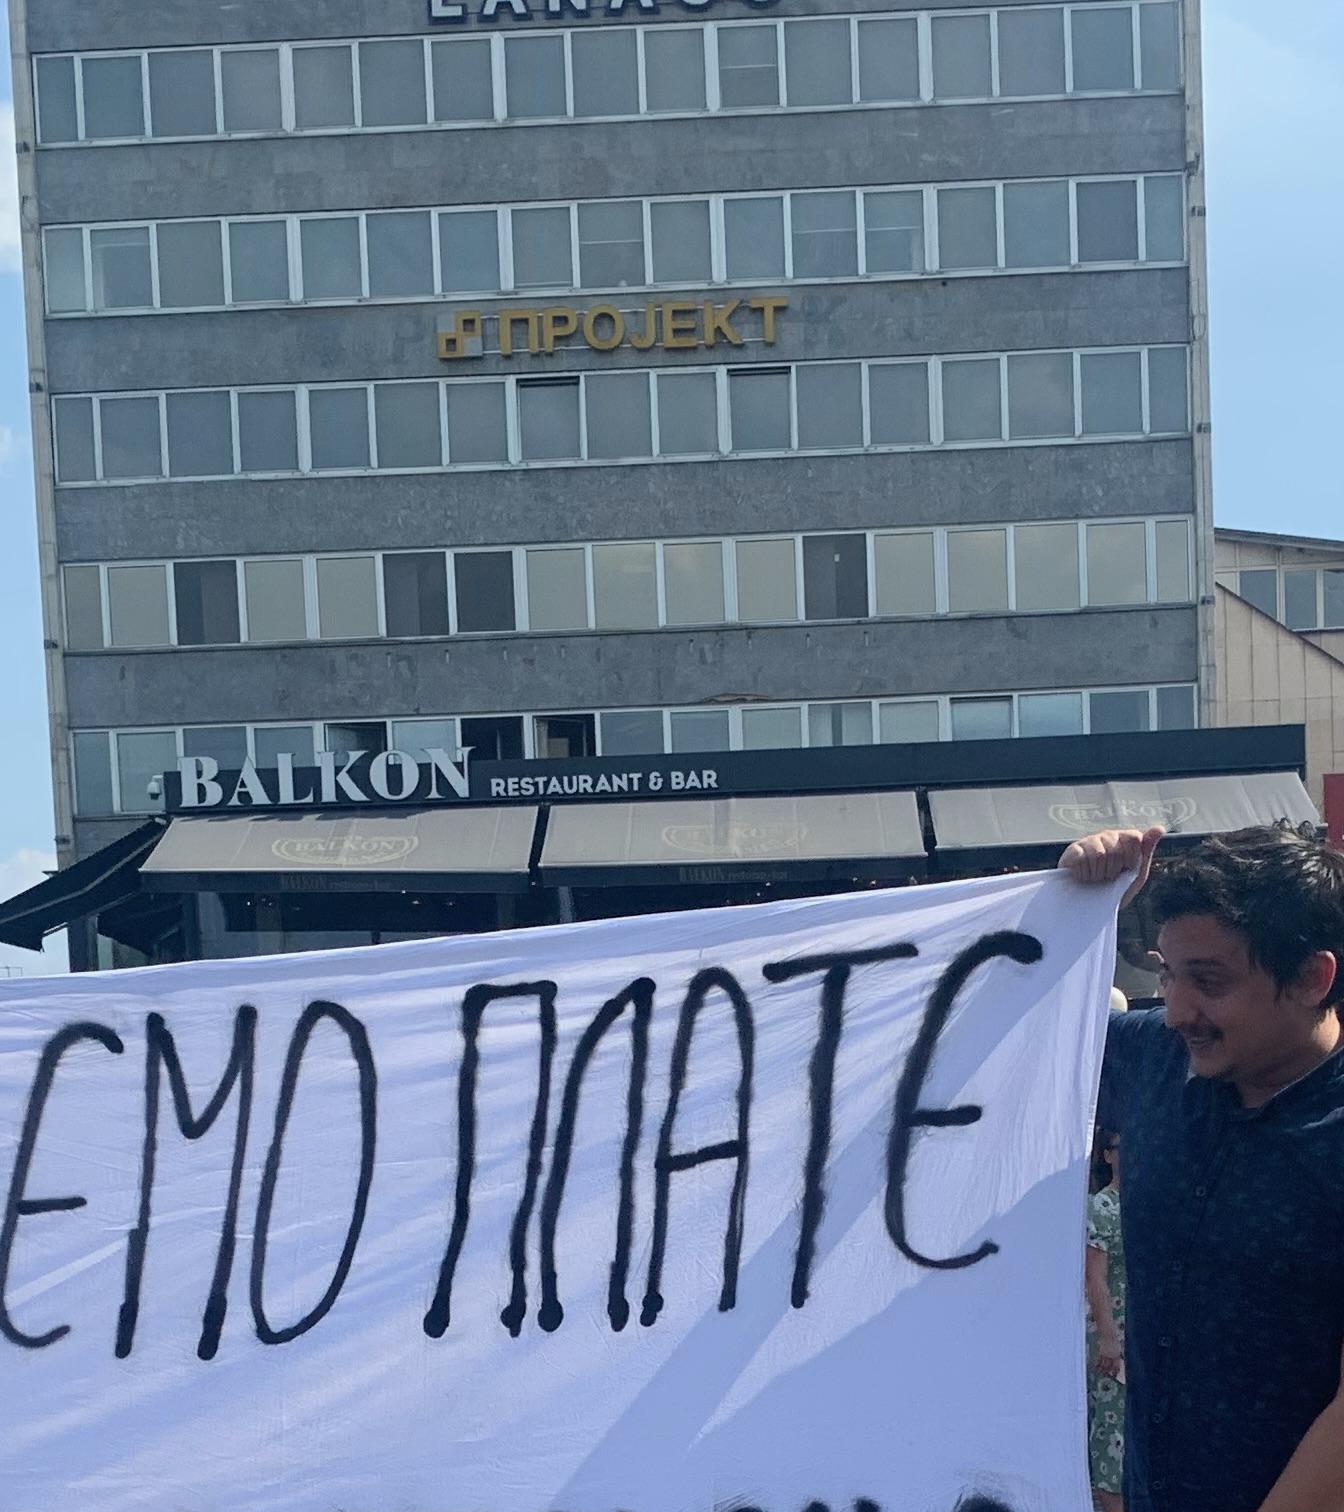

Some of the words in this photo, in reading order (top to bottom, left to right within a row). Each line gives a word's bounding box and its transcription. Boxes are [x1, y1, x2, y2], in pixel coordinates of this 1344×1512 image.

[498, 296, 789, 356] ПРОЈЕКТ
[179, 746, 476, 808] BALKON
[490, 775, 644, 797] RESTAURANT
[648, 771, 664, 791] &
[670, 769, 719, 791] BAR
[422, 929, 1047, 1340] ПЛАТЕ
